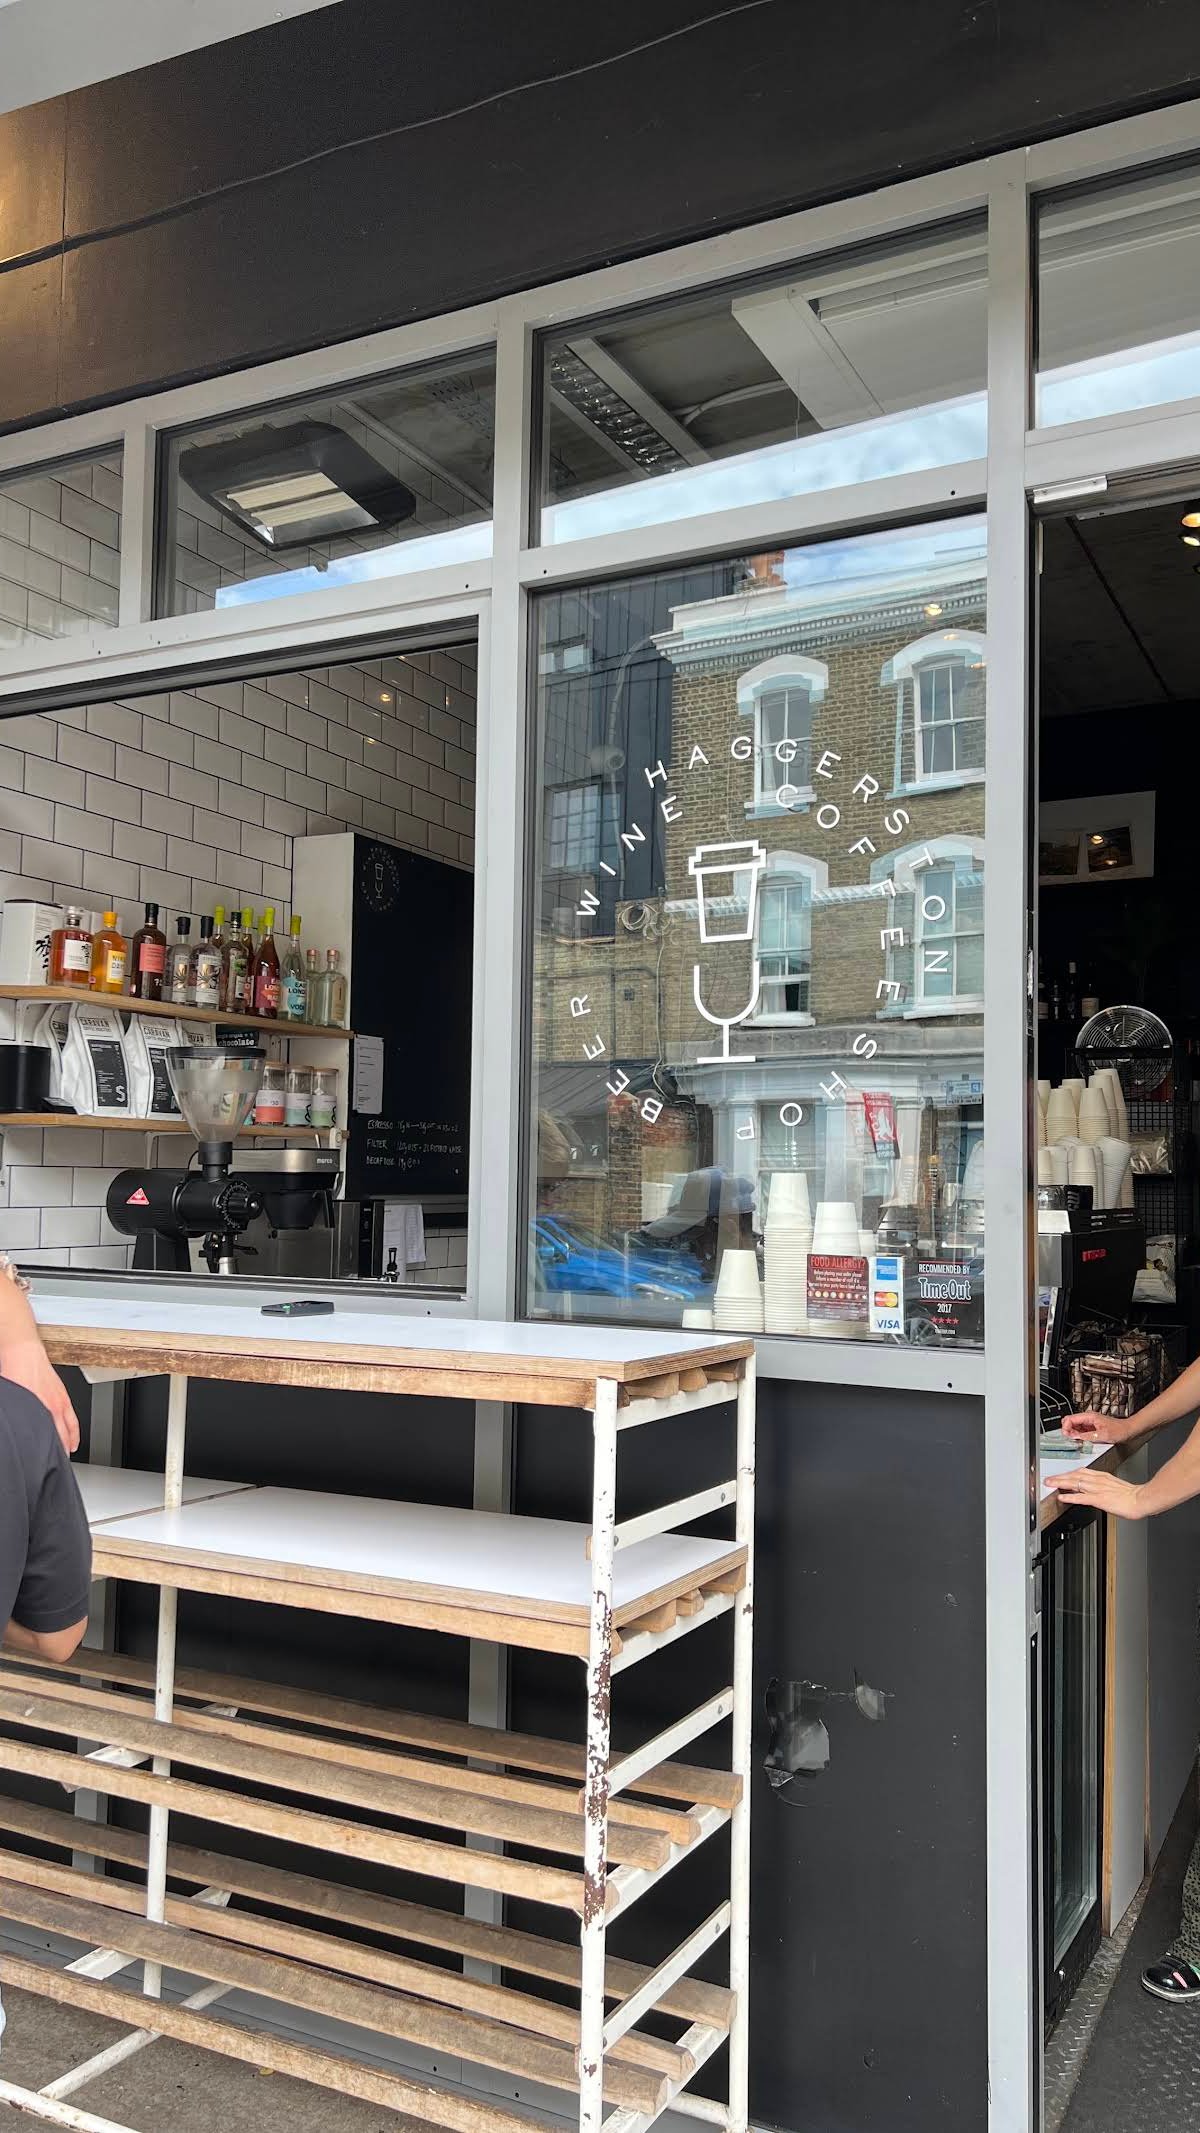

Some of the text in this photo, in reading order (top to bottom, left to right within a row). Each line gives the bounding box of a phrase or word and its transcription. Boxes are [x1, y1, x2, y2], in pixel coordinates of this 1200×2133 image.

[577, 795, 682, 917] WINE
[644, 736, 949, 973] HAGGERSTON
[776, 784, 905, 1000] COFFEE
[218, 1039, 255, 1047] chocolate
[571, 994, 664, 1124] BEER
[737, 1033, 878, 1141] SHOP
[811, 1256, 866, 1269] FOOD ALLERGY?
[919, 1264, 970, 1274] RECOMMENDED BY
[876, 1319, 900, 1329] VISA
[937, 1303, 953, 1313] 2017
